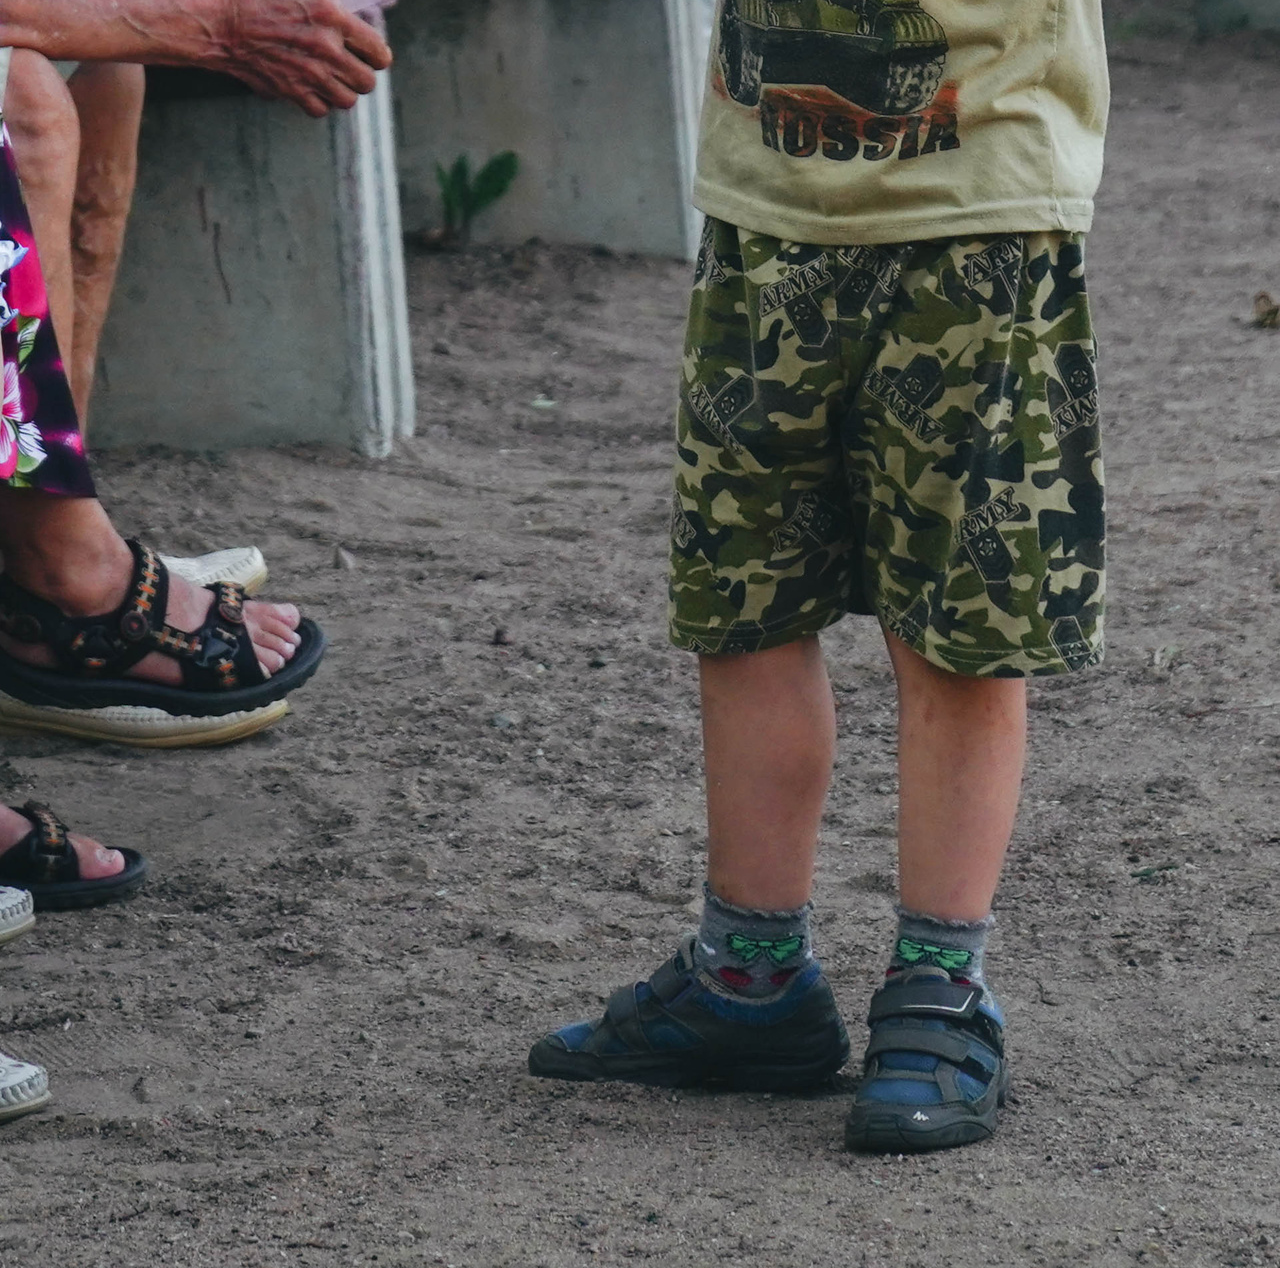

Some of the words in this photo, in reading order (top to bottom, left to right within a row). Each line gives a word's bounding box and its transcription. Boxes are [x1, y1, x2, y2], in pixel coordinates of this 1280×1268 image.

[760, 252, 834, 317] ARMY
[966, 235, 1023, 288] ARM
[955, 486, 1020, 544] RMY
